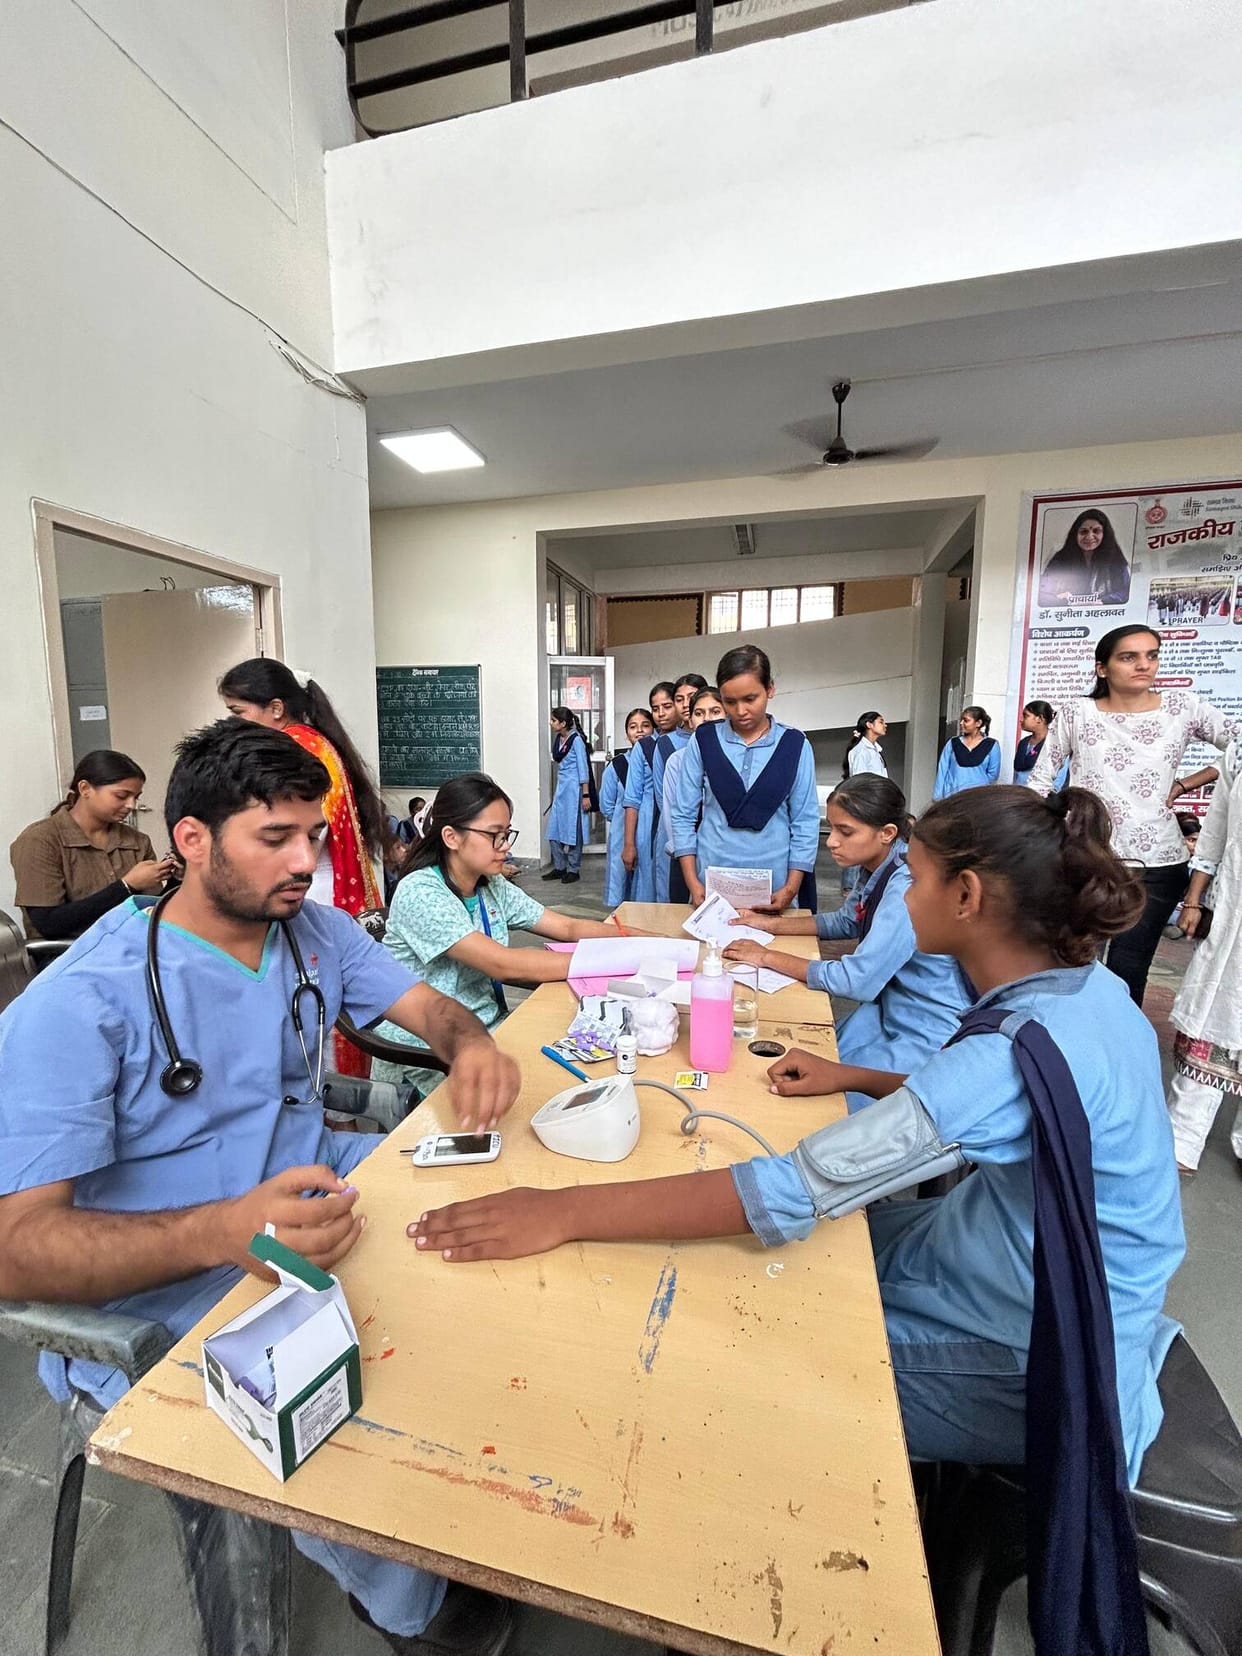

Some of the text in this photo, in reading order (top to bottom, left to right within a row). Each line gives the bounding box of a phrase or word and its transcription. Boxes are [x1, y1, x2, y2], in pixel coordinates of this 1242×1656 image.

[1147, 518, 1236, 549] राजकीय
[1055, 608, 1083, 622] सुनीता
[1084, 609, 1126, 618] अहलावत
